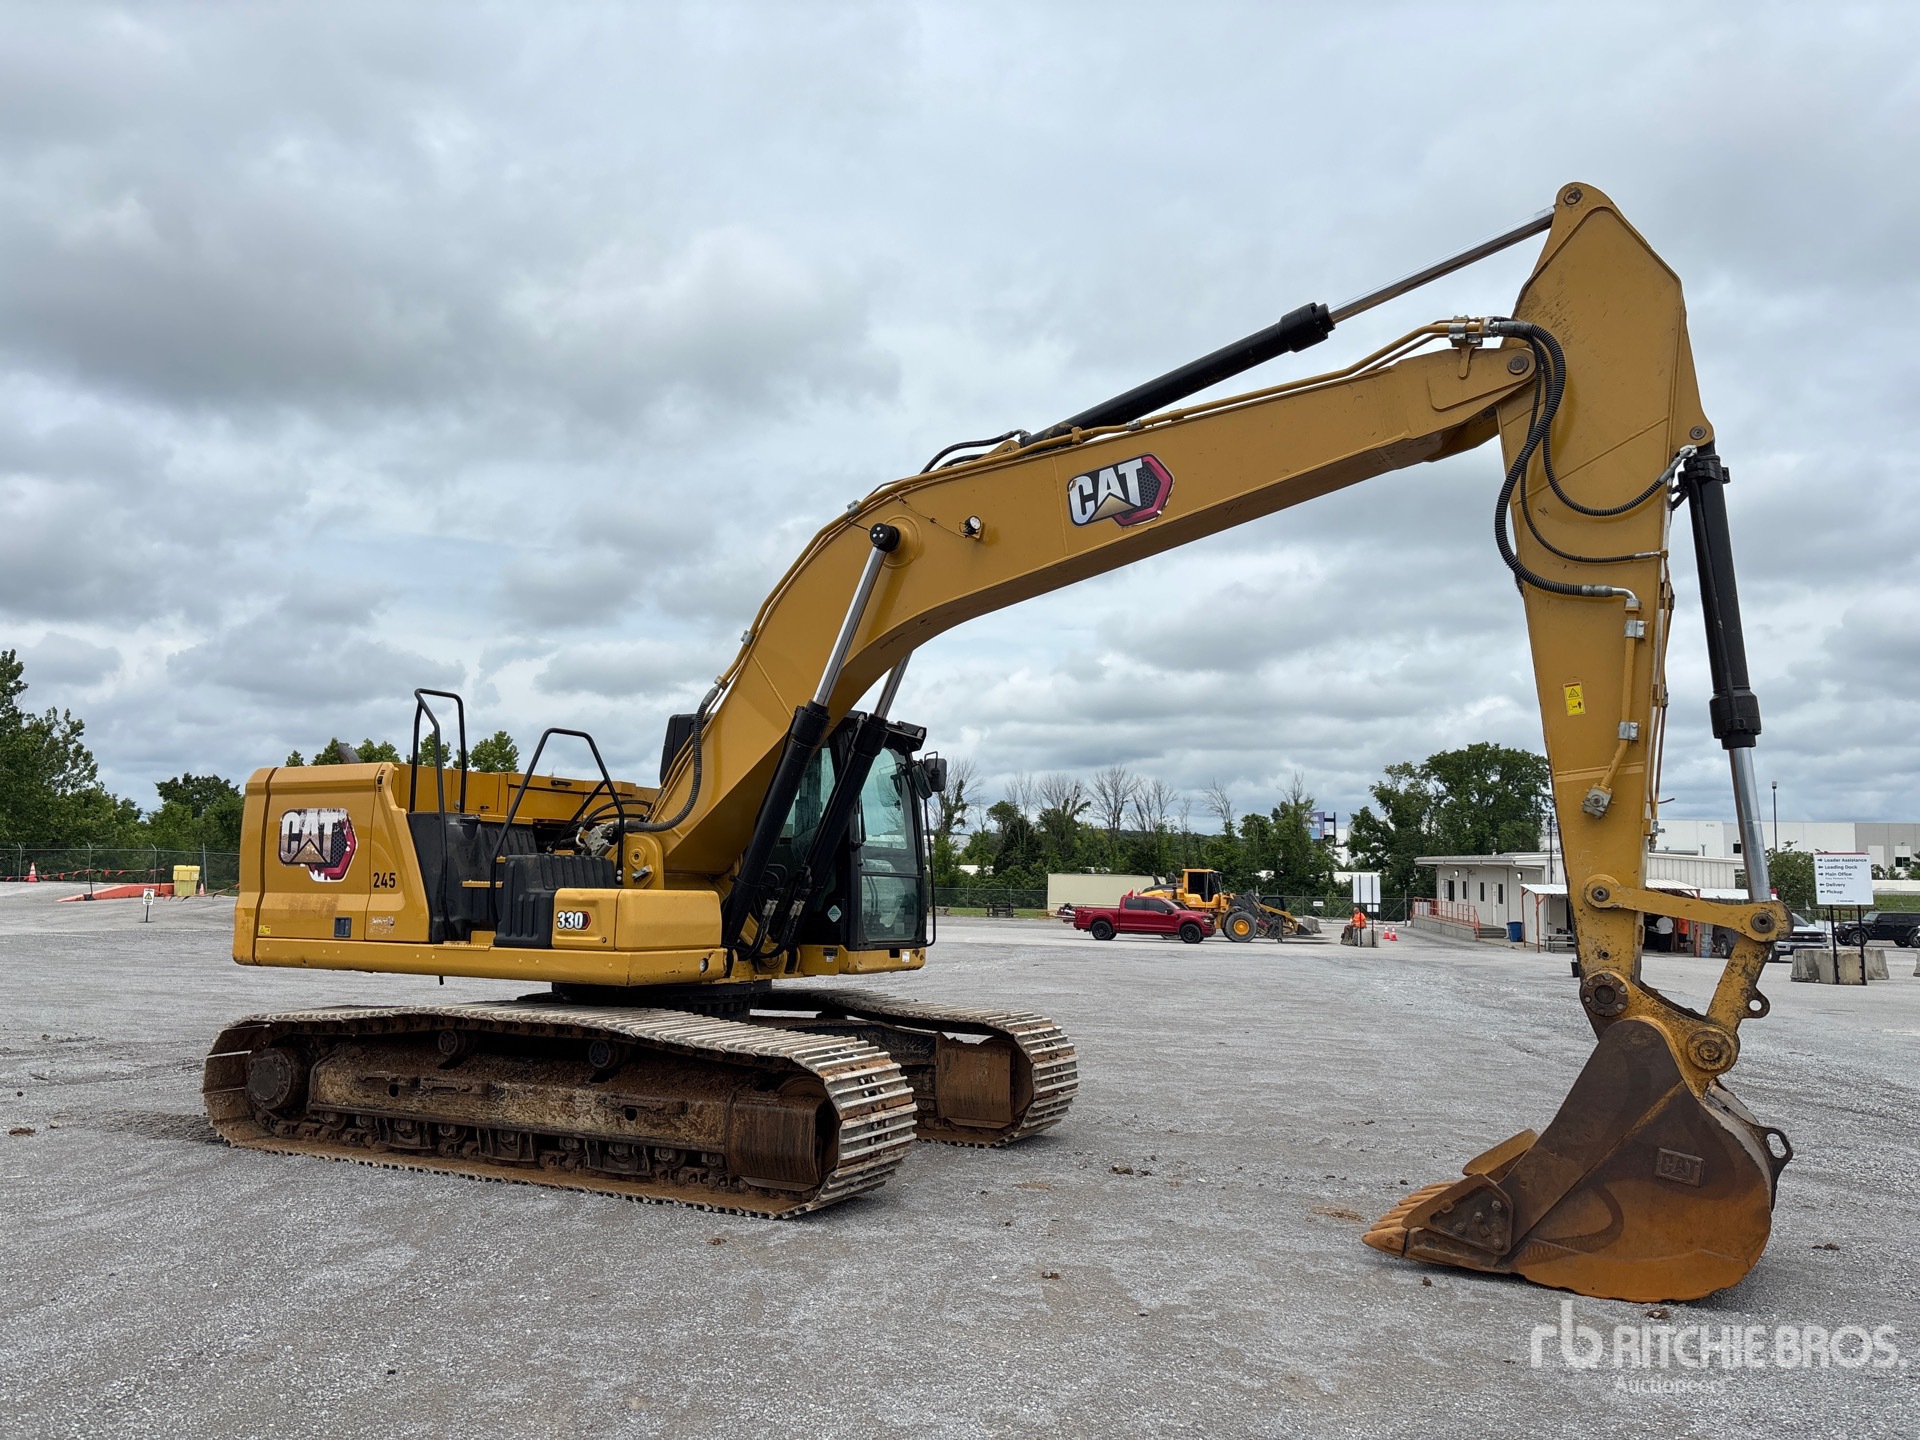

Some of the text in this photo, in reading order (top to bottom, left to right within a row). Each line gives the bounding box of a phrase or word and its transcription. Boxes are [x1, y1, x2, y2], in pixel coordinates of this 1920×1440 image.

[1069, 457, 1143, 525] CAT
[281, 810, 339, 864] CAT
[373, 872, 396, 888] 245
[557, 911, 584, 929] 330
